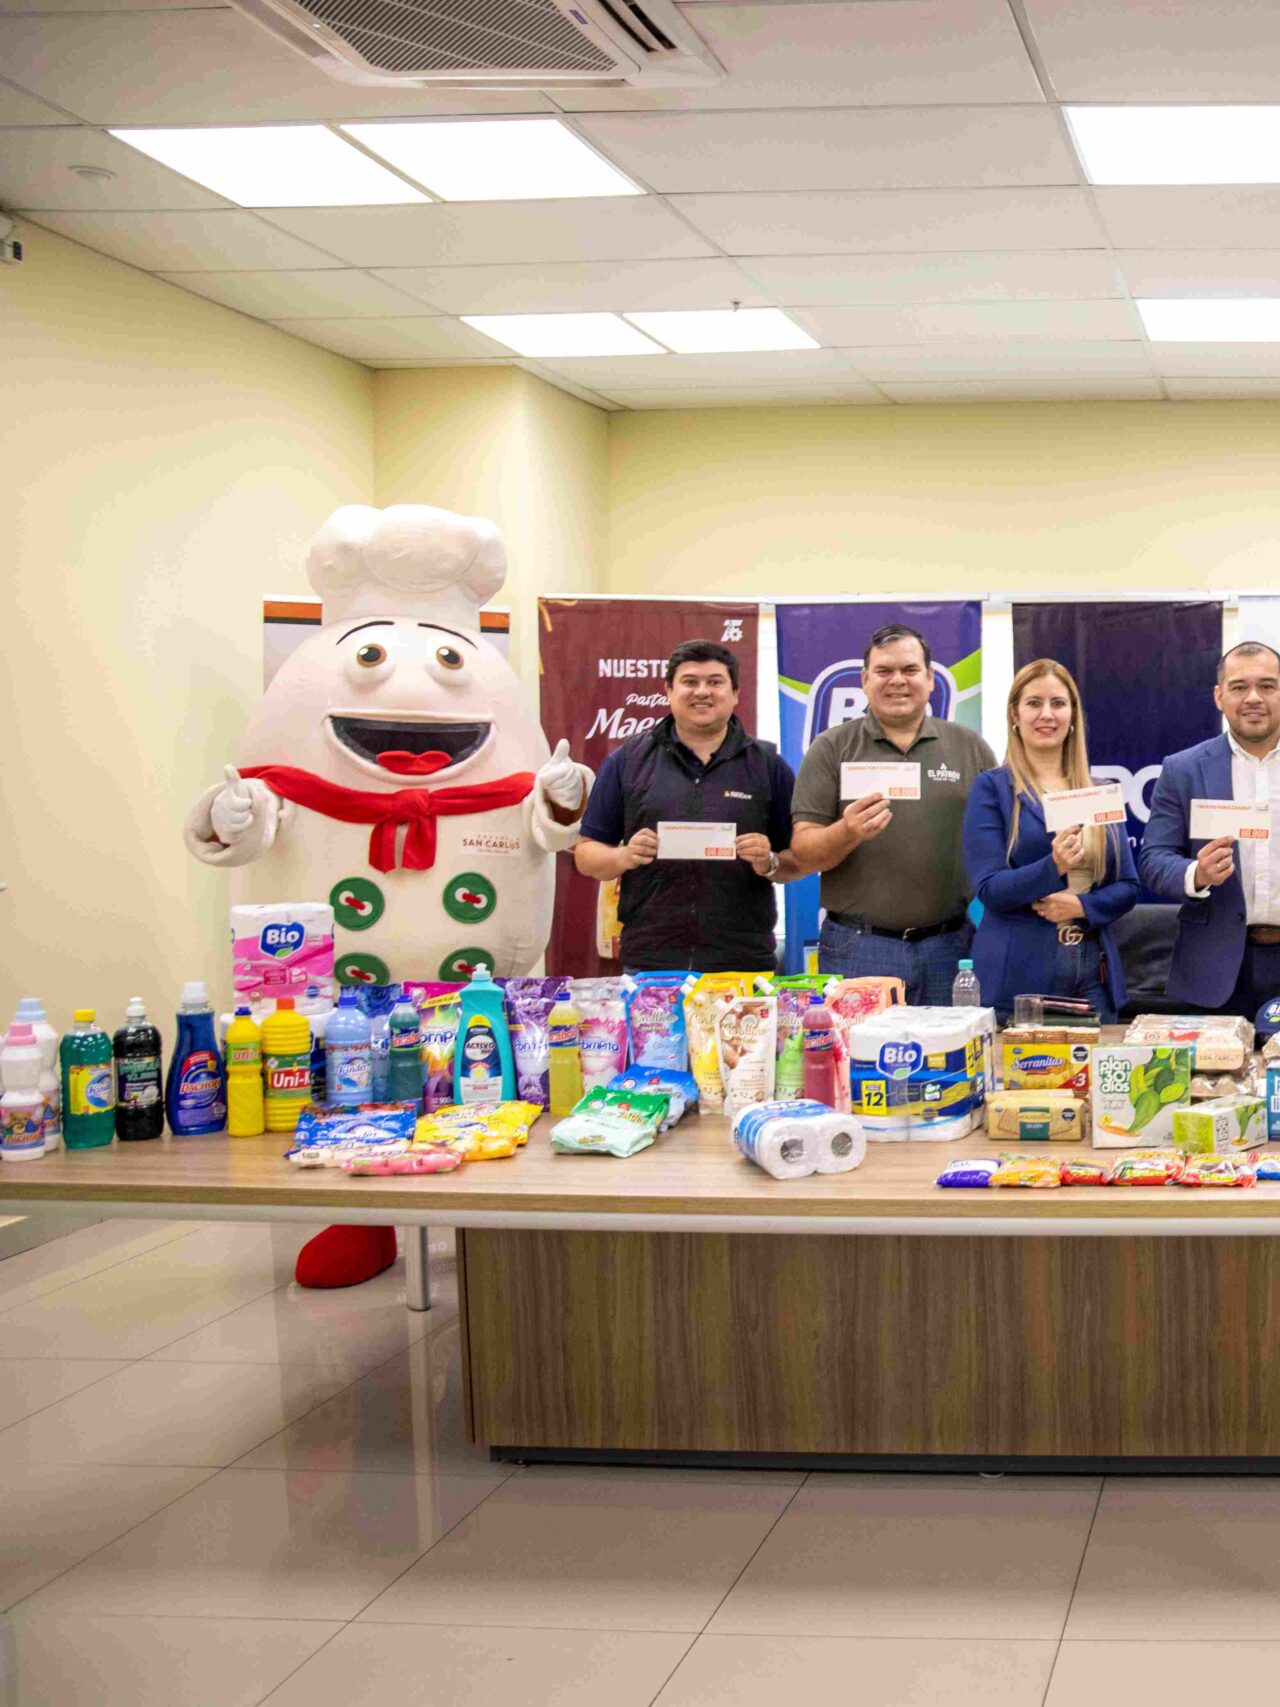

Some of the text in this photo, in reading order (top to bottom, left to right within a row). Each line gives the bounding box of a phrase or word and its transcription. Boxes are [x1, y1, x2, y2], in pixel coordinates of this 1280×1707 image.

[463, 838, 520, 850] SAN CARLOS
[266, 928, 300, 945] Bio
[883, 1046, 918, 1064] Bio
[1100, 1055, 1131, 1077] plan
[865, 1091, 884, 1107] 12
